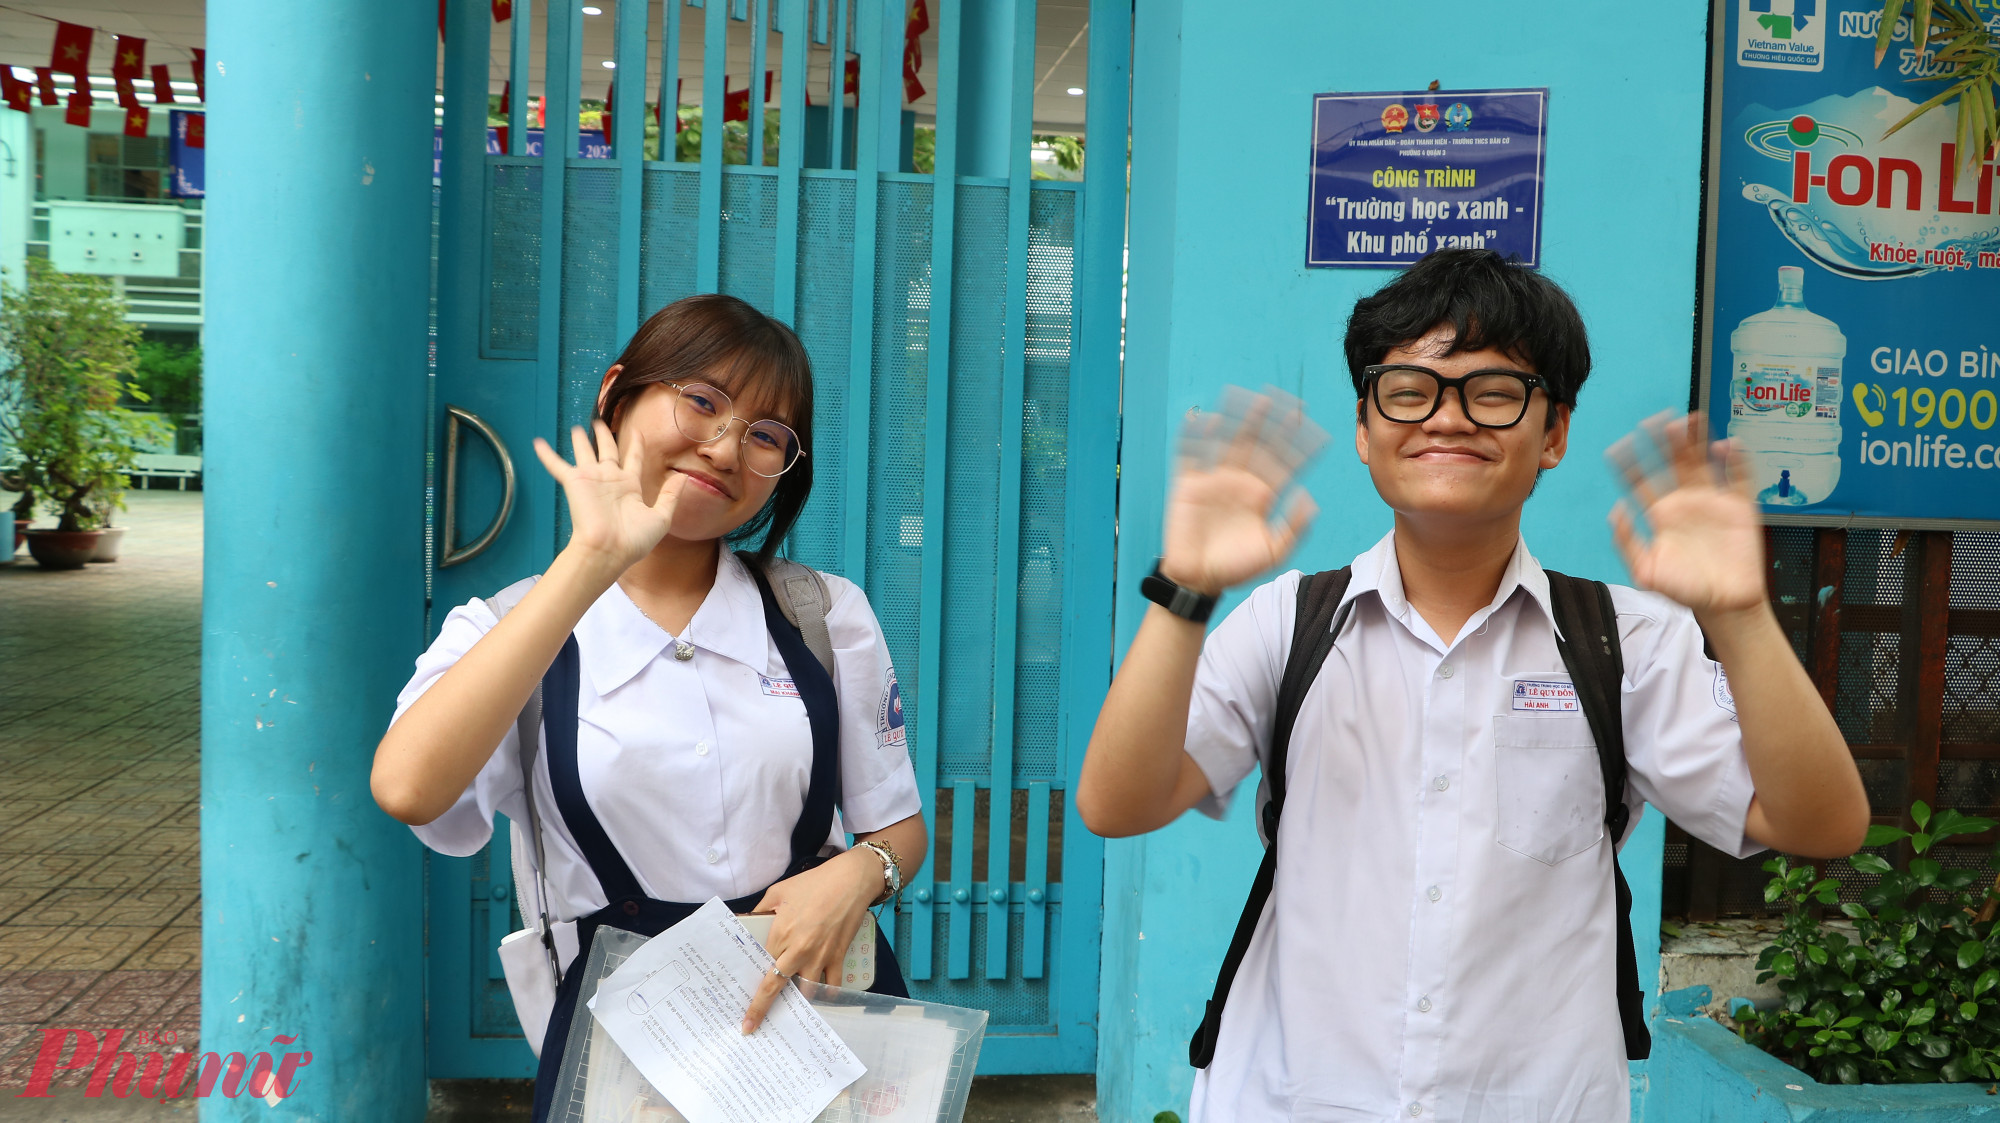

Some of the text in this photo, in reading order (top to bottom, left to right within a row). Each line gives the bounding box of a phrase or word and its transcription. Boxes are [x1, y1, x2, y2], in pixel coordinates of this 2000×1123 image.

[1748, 39, 1814, 52] Vietnam Value
[1373, 166, 1475, 188] CÔNG TRÌNH
[1938, 142, 2000, 214] Li
[1412, 197, 1449, 224] học
[1457, 197, 1508, 220] xanh
[1347, 231, 1384, 253] Khu
[1391, 228, 1431, 256] phố
[1870, 242, 1917, 263] Khỏe
[1925, 246, 1971, 270] ruột,
[1870, 346, 1948, 377] GIAO
[1780, 383, 1811, 402] Life
[1892, 387, 1998, 430] 1900
[1540, 688, 1556, 697] QUÝ
[1558, 689, 1574, 697] ĐÔN
